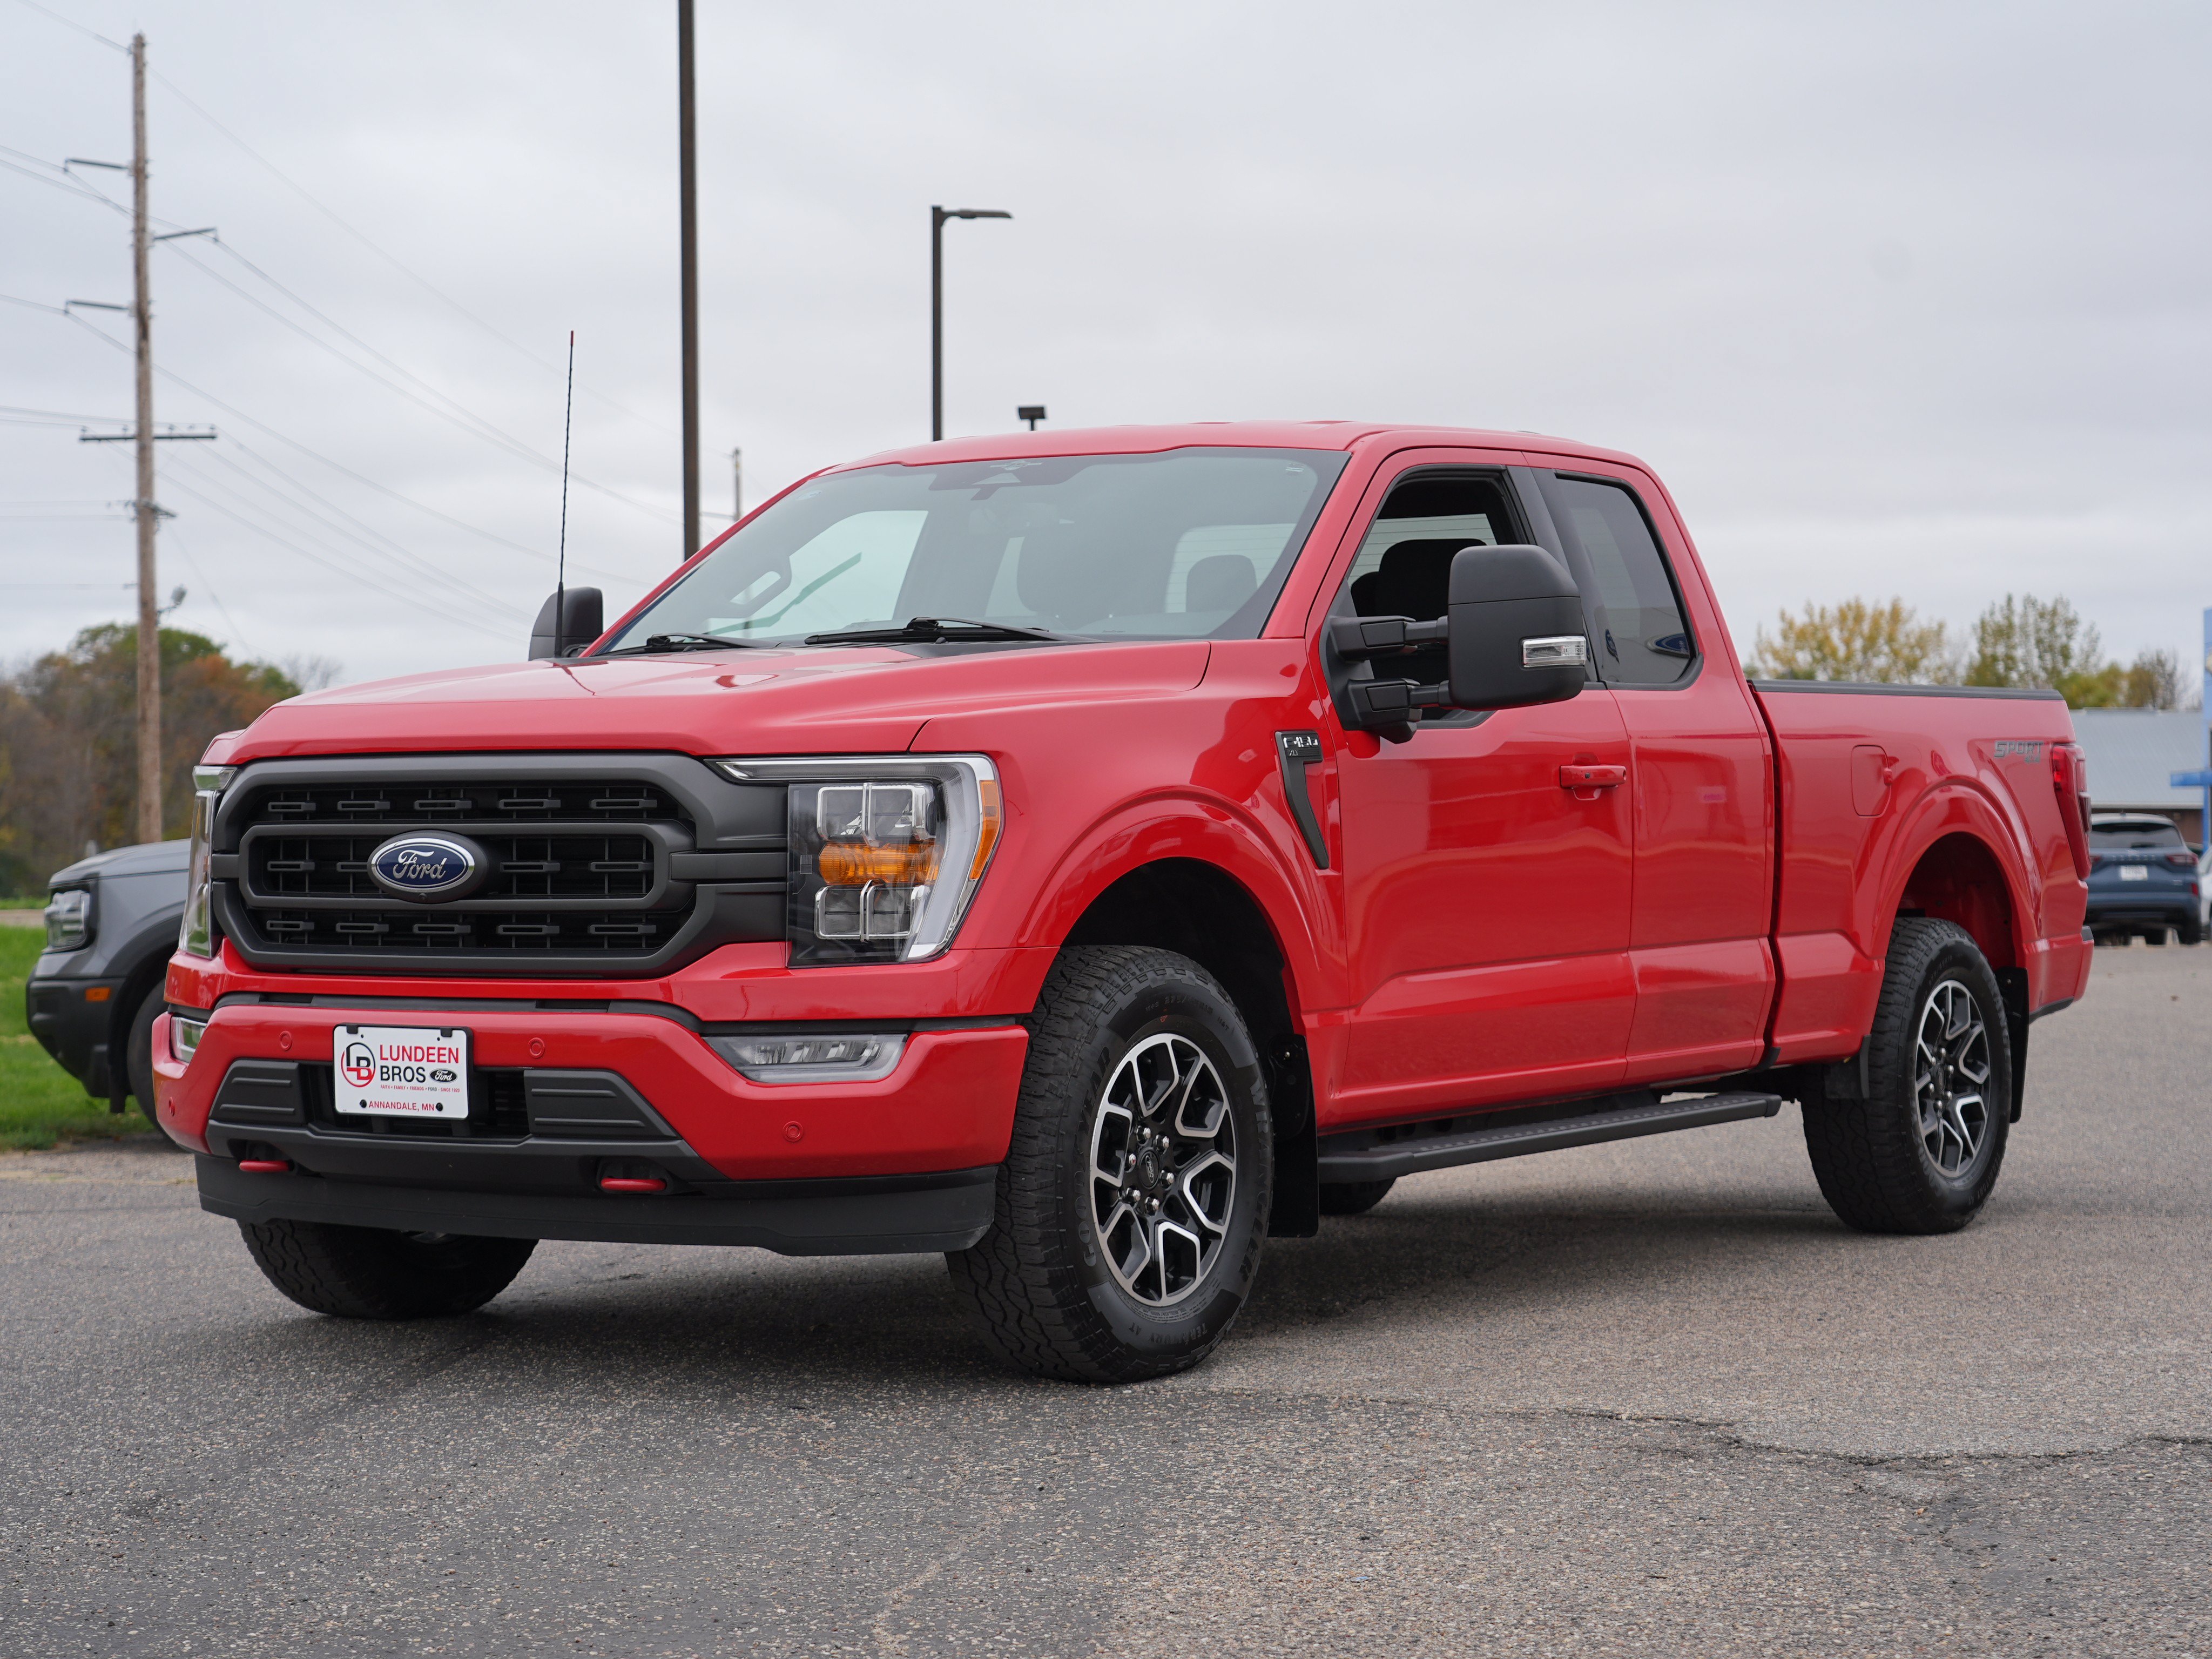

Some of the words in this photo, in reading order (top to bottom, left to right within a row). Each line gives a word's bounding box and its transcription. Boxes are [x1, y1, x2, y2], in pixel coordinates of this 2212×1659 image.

[1994, 740, 2044, 758] SPORT
[393, 849, 448, 879] Ford
[380, 1044, 459, 1064] LUNDEEN
[380, 1065, 426, 1083] BROS
[434, 1069, 453, 1082] Ford
[369, 1100, 420, 1112] ANNANDALE,
[422, 1103, 434, 1111] MN
[1238, 1079, 1271, 1284] WRANGLER
